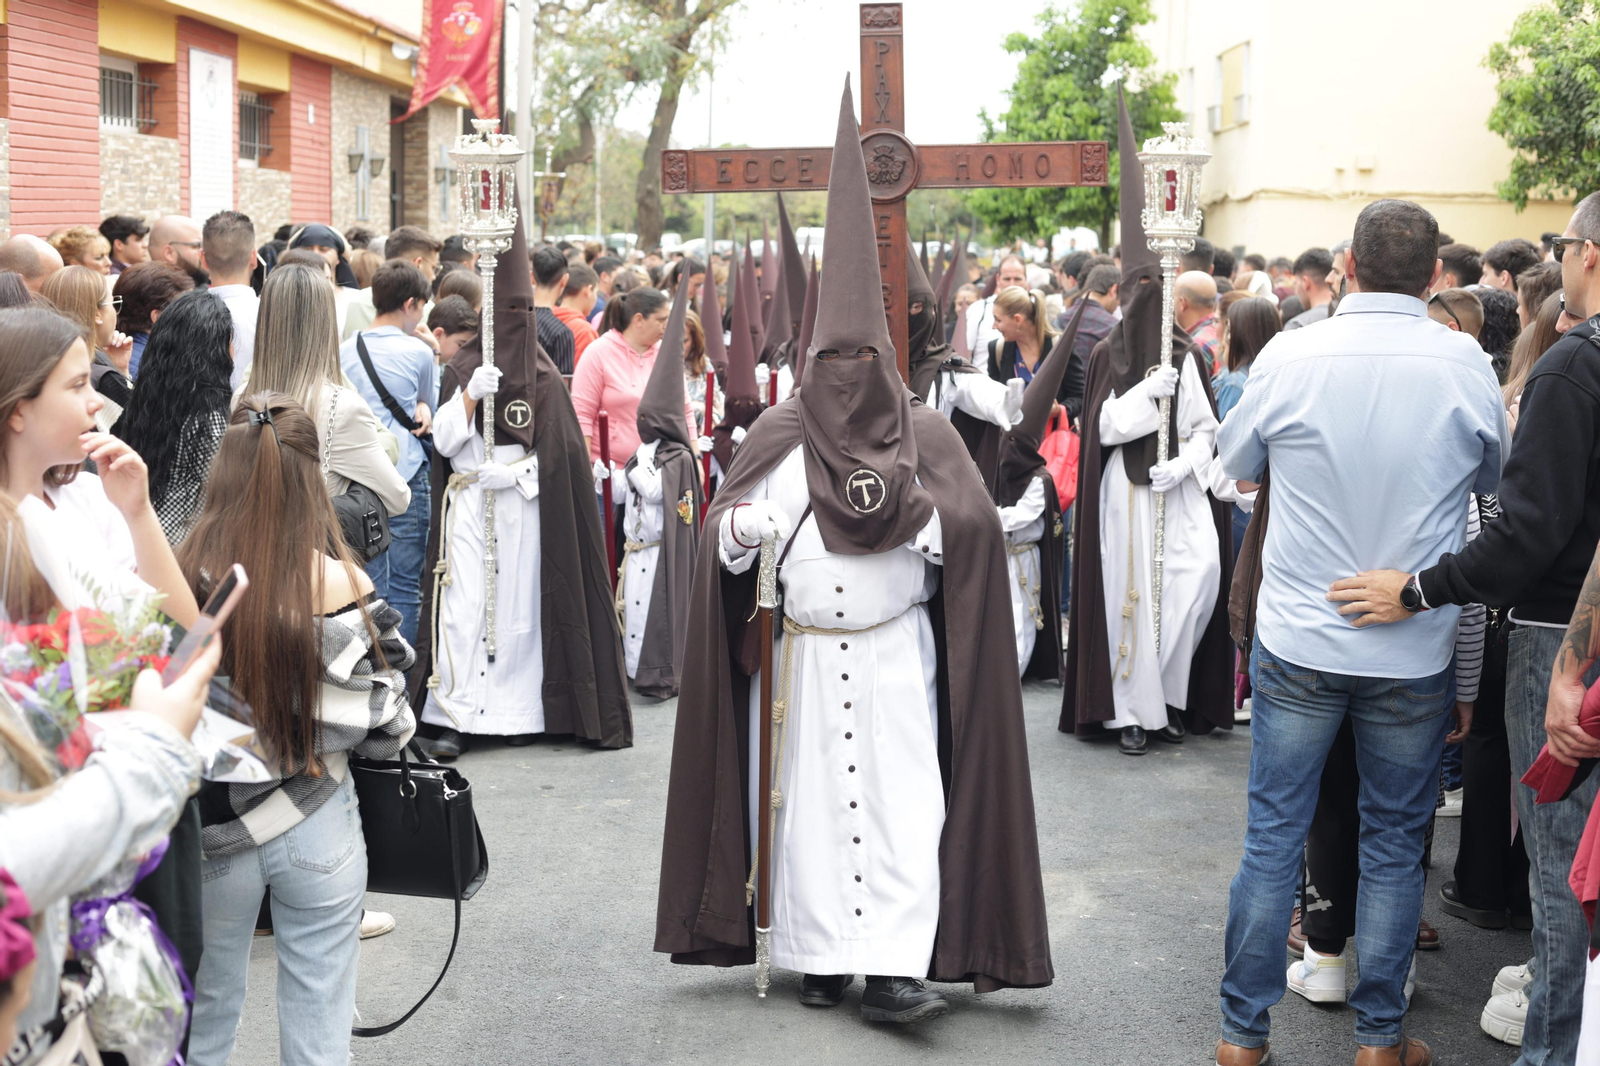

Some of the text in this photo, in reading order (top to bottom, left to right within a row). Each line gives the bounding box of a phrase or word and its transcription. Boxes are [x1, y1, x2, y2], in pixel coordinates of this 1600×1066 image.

[874, 40, 890, 123] PAX
[716, 152, 1051, 184] ECCE HOMO
